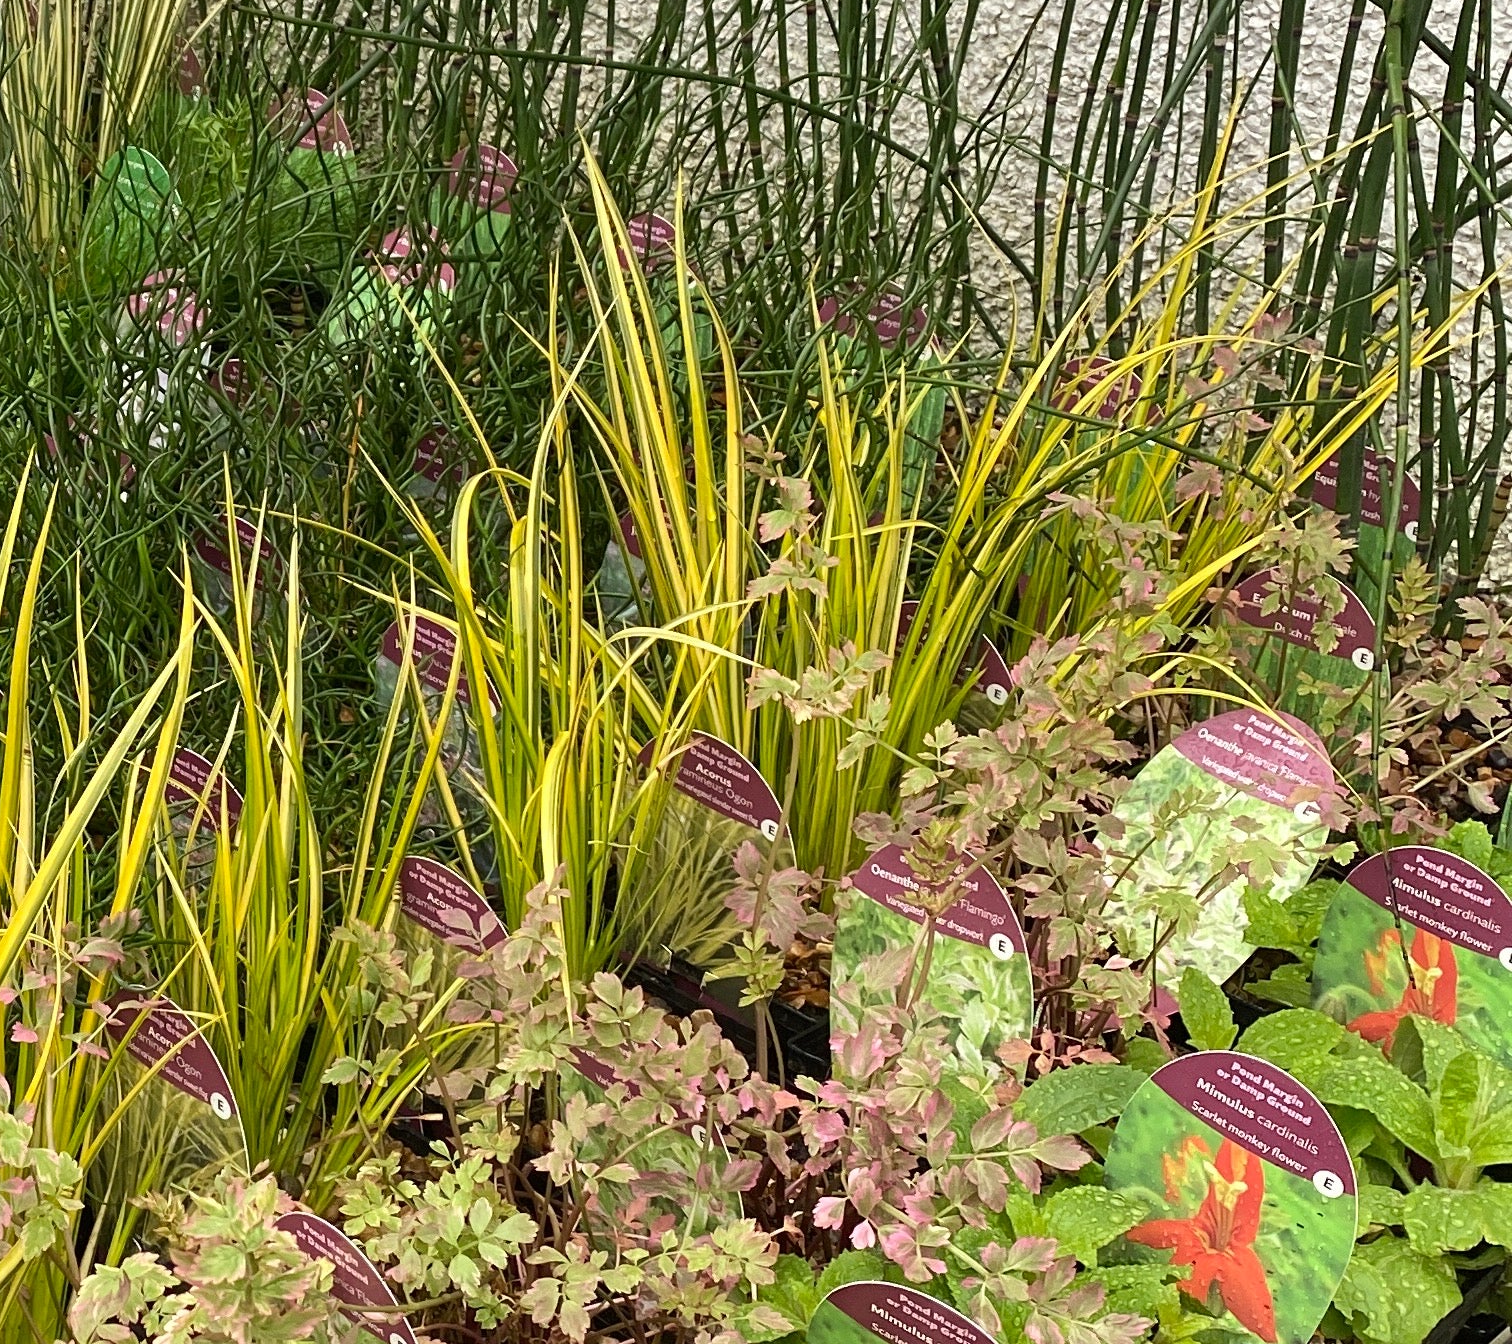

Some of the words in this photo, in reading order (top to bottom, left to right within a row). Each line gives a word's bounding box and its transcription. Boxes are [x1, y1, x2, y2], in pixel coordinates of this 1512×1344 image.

[1360, 654, 1367, 664] E
[995, 689, 1001, 699] E
[1248, 715, 1273, 731] Pond
[1198, 728, 1243, 756] Oenanthe
[1233, 724, 1245, 732] or
[1245, 726, 1272, 746] Damp
[1272, 739, 1309, 761] Ground
[696, 763, 731, 788] Acorus
[717, 760, 749, 782] Ground
[679, 766, 724, 794] ramineus
[726, 788, 753, 809] Ogon
[768, 825, 775, 836] E
[871, 864, 920, 891] Oenanthe
[1404, 863, 1416, 872] or
[1417, 867, 1448, 888] Damp
[1450, 882, 1492, 907] Ground
[1416, 854, 1444, 874] Pond
[1445, 867, 1483, 891] Margin
[1418, 914, 1458, 938] monkey
[1460, 931, 1493, 952] flower
[1444, 903, 1501, 934] cardinalis
[998, 940, 1006, 952] E
[1217, 1069, 1230, 1080] or
[1231, 1075, 1266, 1100] Damp
[1267, 1096, 1312, 1126] Ground
[1231, 1062, 1263, 1084] Pond
[1263, 1079, 1304, 1108] Margin
[218, 1100, 224, 1111] E
[1196, 1078, 1255, 1119] Mimulus
[1257, 1115, 1319, 1155] cardinalis
[1191, 1100, 1228, 1128] Scarlet
[1228, 1124, 1270, 1153] monkey
[1271, 1147, 1307, 1173] flower
[1323, 1177, 1334, 1190] E
[871, 1304, 933, 1344] Mimulus
[887, 1298, 900, 1308] or
[903, 1306, 938, 1330] Damp
[900, 1294, 930, 1316] Pond
[933, 1312, 976, 1341] Margin
